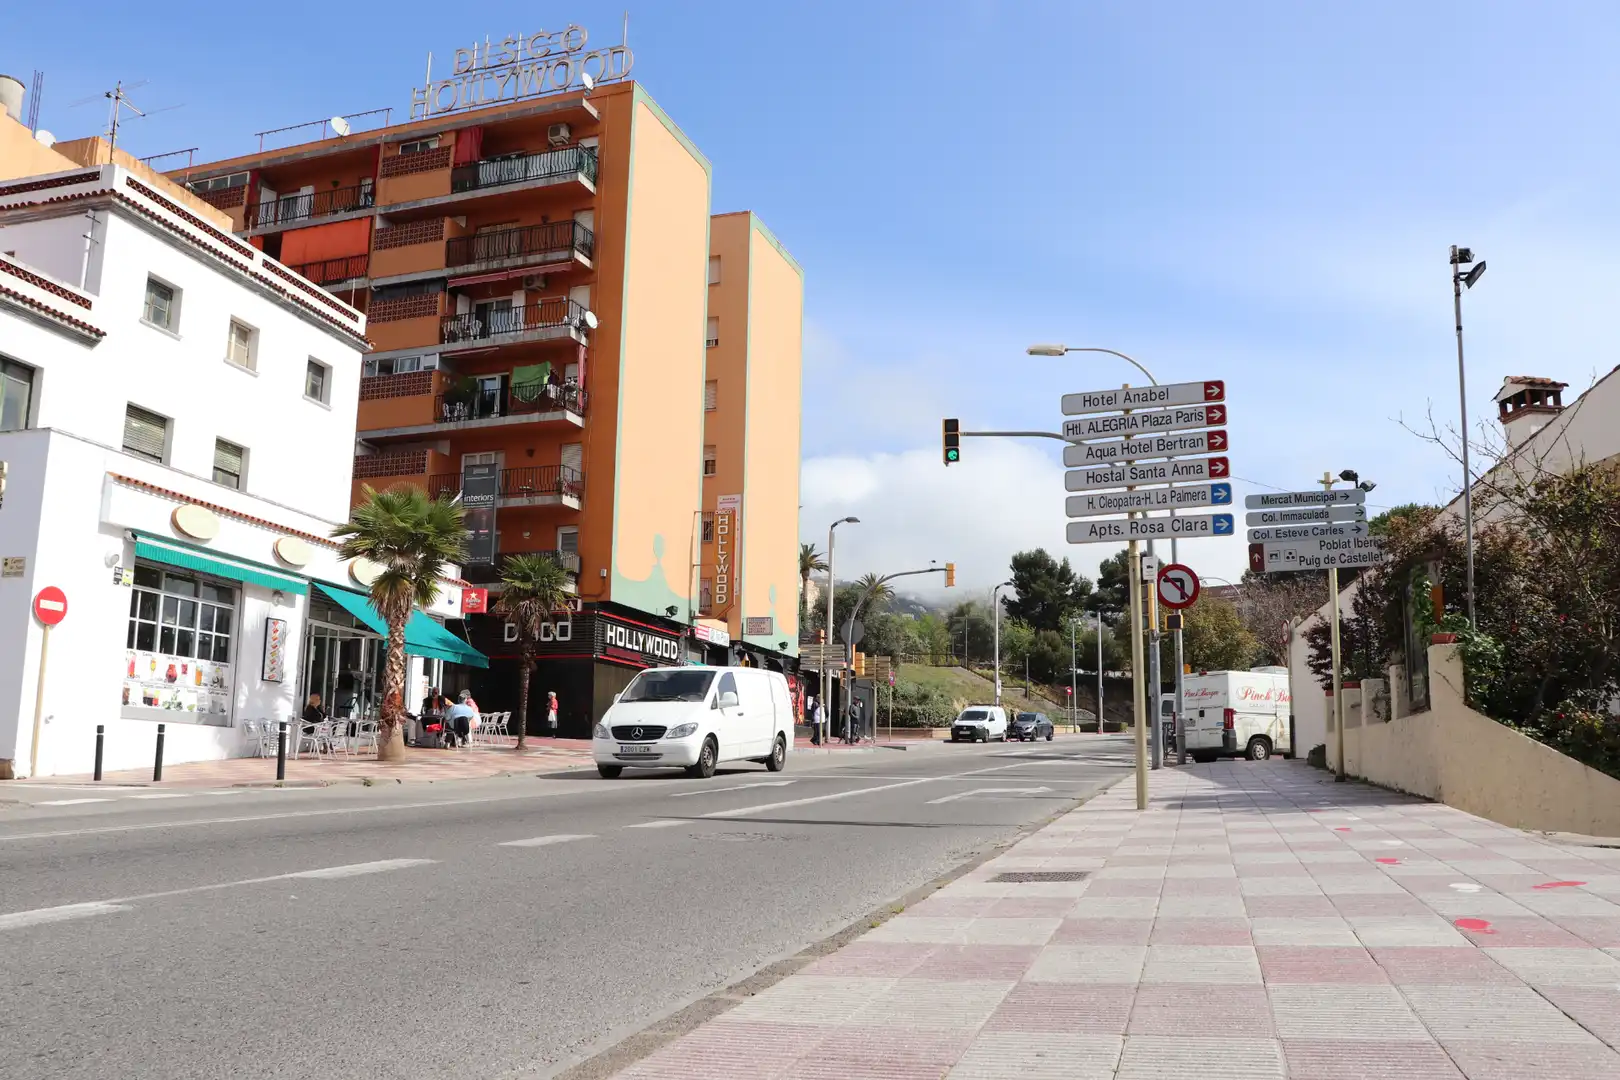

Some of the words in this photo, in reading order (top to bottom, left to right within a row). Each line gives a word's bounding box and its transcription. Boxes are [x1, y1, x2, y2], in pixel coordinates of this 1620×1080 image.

[454, 24, 588, 76] DISCO
[410, 46, 634, 119] HOLLYWOOD
[1083, 393, 1117, 408] Hotel
[1123, 387, 1169, 404] Anabel
[1066, 422, 1084, 437] Htl.
[1087, 417, 1138, 434] ALEGRIA
[1141, 414, 1172, 428] Plaza
[1176, 409, 1204, 423] Paris
[1085, 446, 1117, 461] Aqua
[1121, 440, 1153, 455] Hotel
[1156, 436, 1204, 452] Bertran
[1086, 469, 1125, 484] Hostal
[1129, 466, 1165, 480] Santa
[1171, 463, 1203, 477] Anna
[1087, 498, 1096, 510] H.
[1156, 491, 1168, 504] La
[1170, 488, 1207, 503] Palmera
[1261, 495, 1292, 506] Mercat
[1294, 491, 1337, 504] Municipal
[1261, 512, 1278, 523] Col.
[1280, 510, 1329, 521] Immaculada
[1088, 523, 1124, 539] Apts.
[1130, 520, 1164, 534] Rosa
[1171, 518, 1208, 532] Clara
[1253, 530, 1272, 540] Col.
[1275, 528, 1309, 539] Esteve
[1312, 525, 1345, 536] Carles
[1319, 537, 1351, 550] Poblat
[715, 515, 729, 604] HOLLYWOOD
[1299, 555, 1320, 567] Puig
[1323, 554, 1336, 565] de
[1338, 551, 1384, 564] Castellet
[504, 621, 572, 643] DCO
[606, 623, 679, 660] HOLLYWOOD
